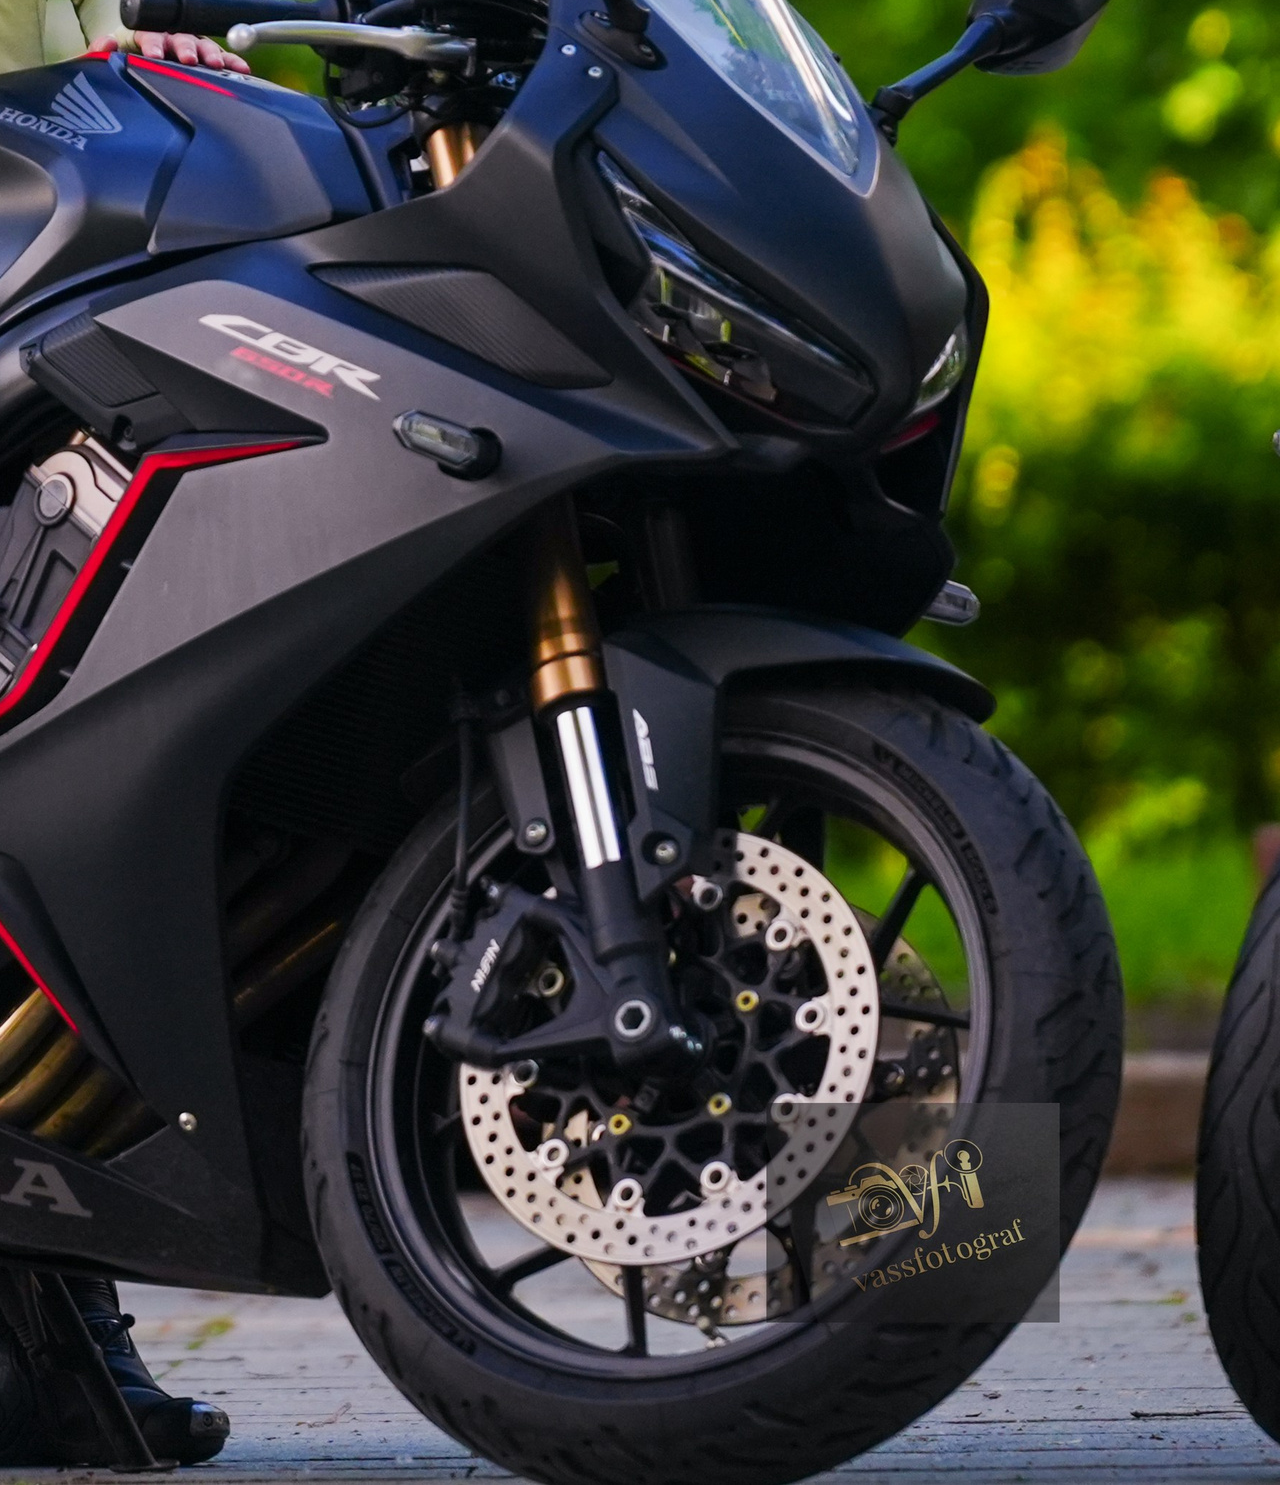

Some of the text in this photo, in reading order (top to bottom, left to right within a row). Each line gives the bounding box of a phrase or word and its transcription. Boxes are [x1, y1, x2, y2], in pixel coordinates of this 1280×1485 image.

[198, 314, 382, 401] CBR
[632, 708, 659, 790] ABS
[471, 938, 500, 993] NISSIN
